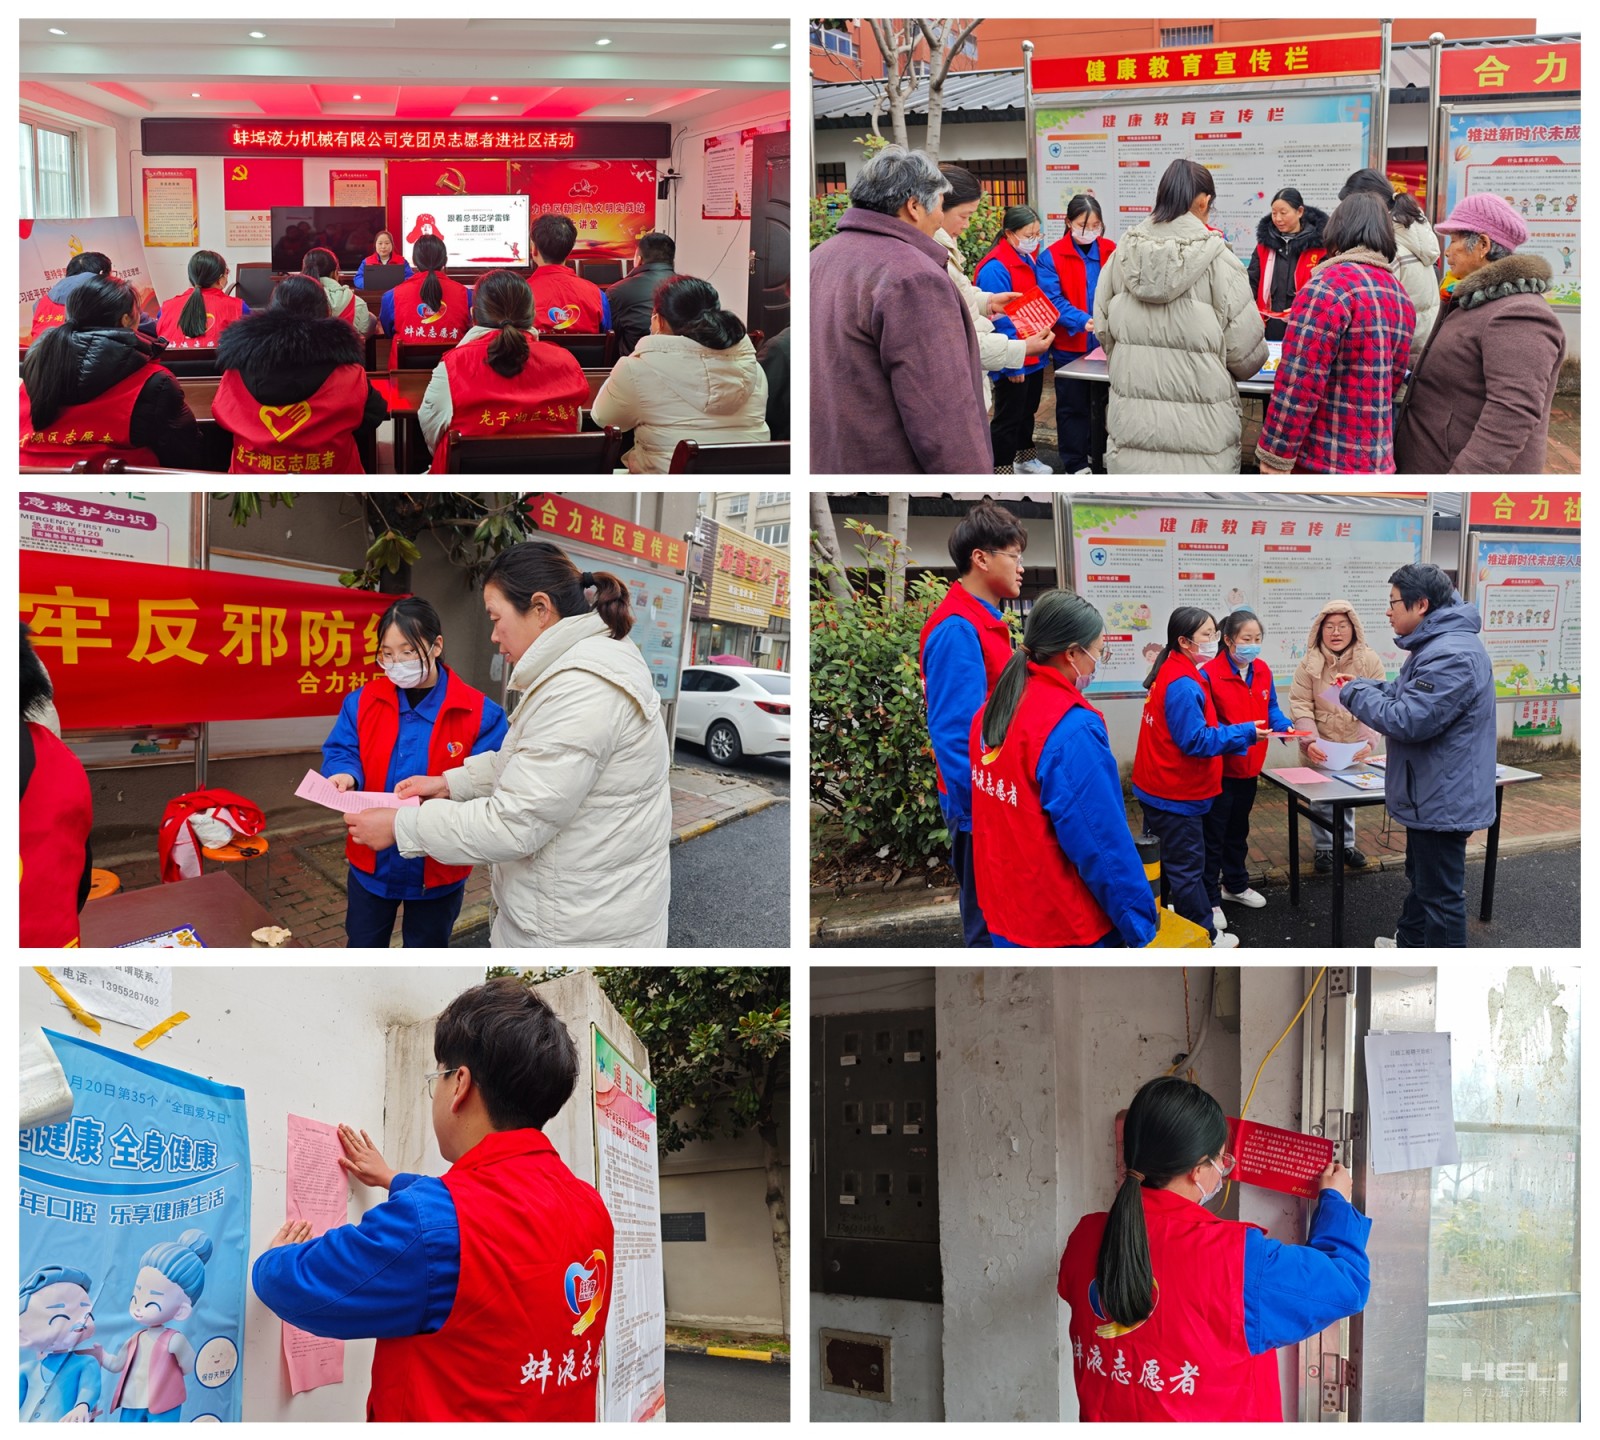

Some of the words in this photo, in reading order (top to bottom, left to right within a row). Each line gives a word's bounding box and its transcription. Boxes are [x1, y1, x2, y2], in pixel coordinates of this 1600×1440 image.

[1086, 46, 1310, 83] 健康教育宣传栏
[1473, 51, 1568, 87] 合力
[1102, 107, 1285, 128] 健康教育宣传栏
[233, 129, 575, 149] 蚌埠液力机械有限公司党团员志愿者进社区活动
[1467, 125, 1581, 143] 推进新时代未成
[447, 213, 511, 223] 跟着总书记学雷锋
[463, 224, 495, 233] 主题团课
[404, 326, 459, 340] 蚌液志愿者
[236, 444, 335, 472] 龙子湖区志愿者
[19, 495, 149, 527] 急救护知识
[78, 521, 103, 531] FIRST
[105, 526, 121, 534] AID
[541, 498, 679, 564] 合力社区宣传栏
[1159, 516, 1353, 537] 健康教育宣传栏
[613, 1061, 643, 1107] 通知栏
[109, 1123, 218, 1174] 全身健康
[19, 1187, 99, 1225] 年口腔
[109, 1186, 226, 1227] 乐享健康生活
[201, 1368, 232, 1382] 保存天然牙
